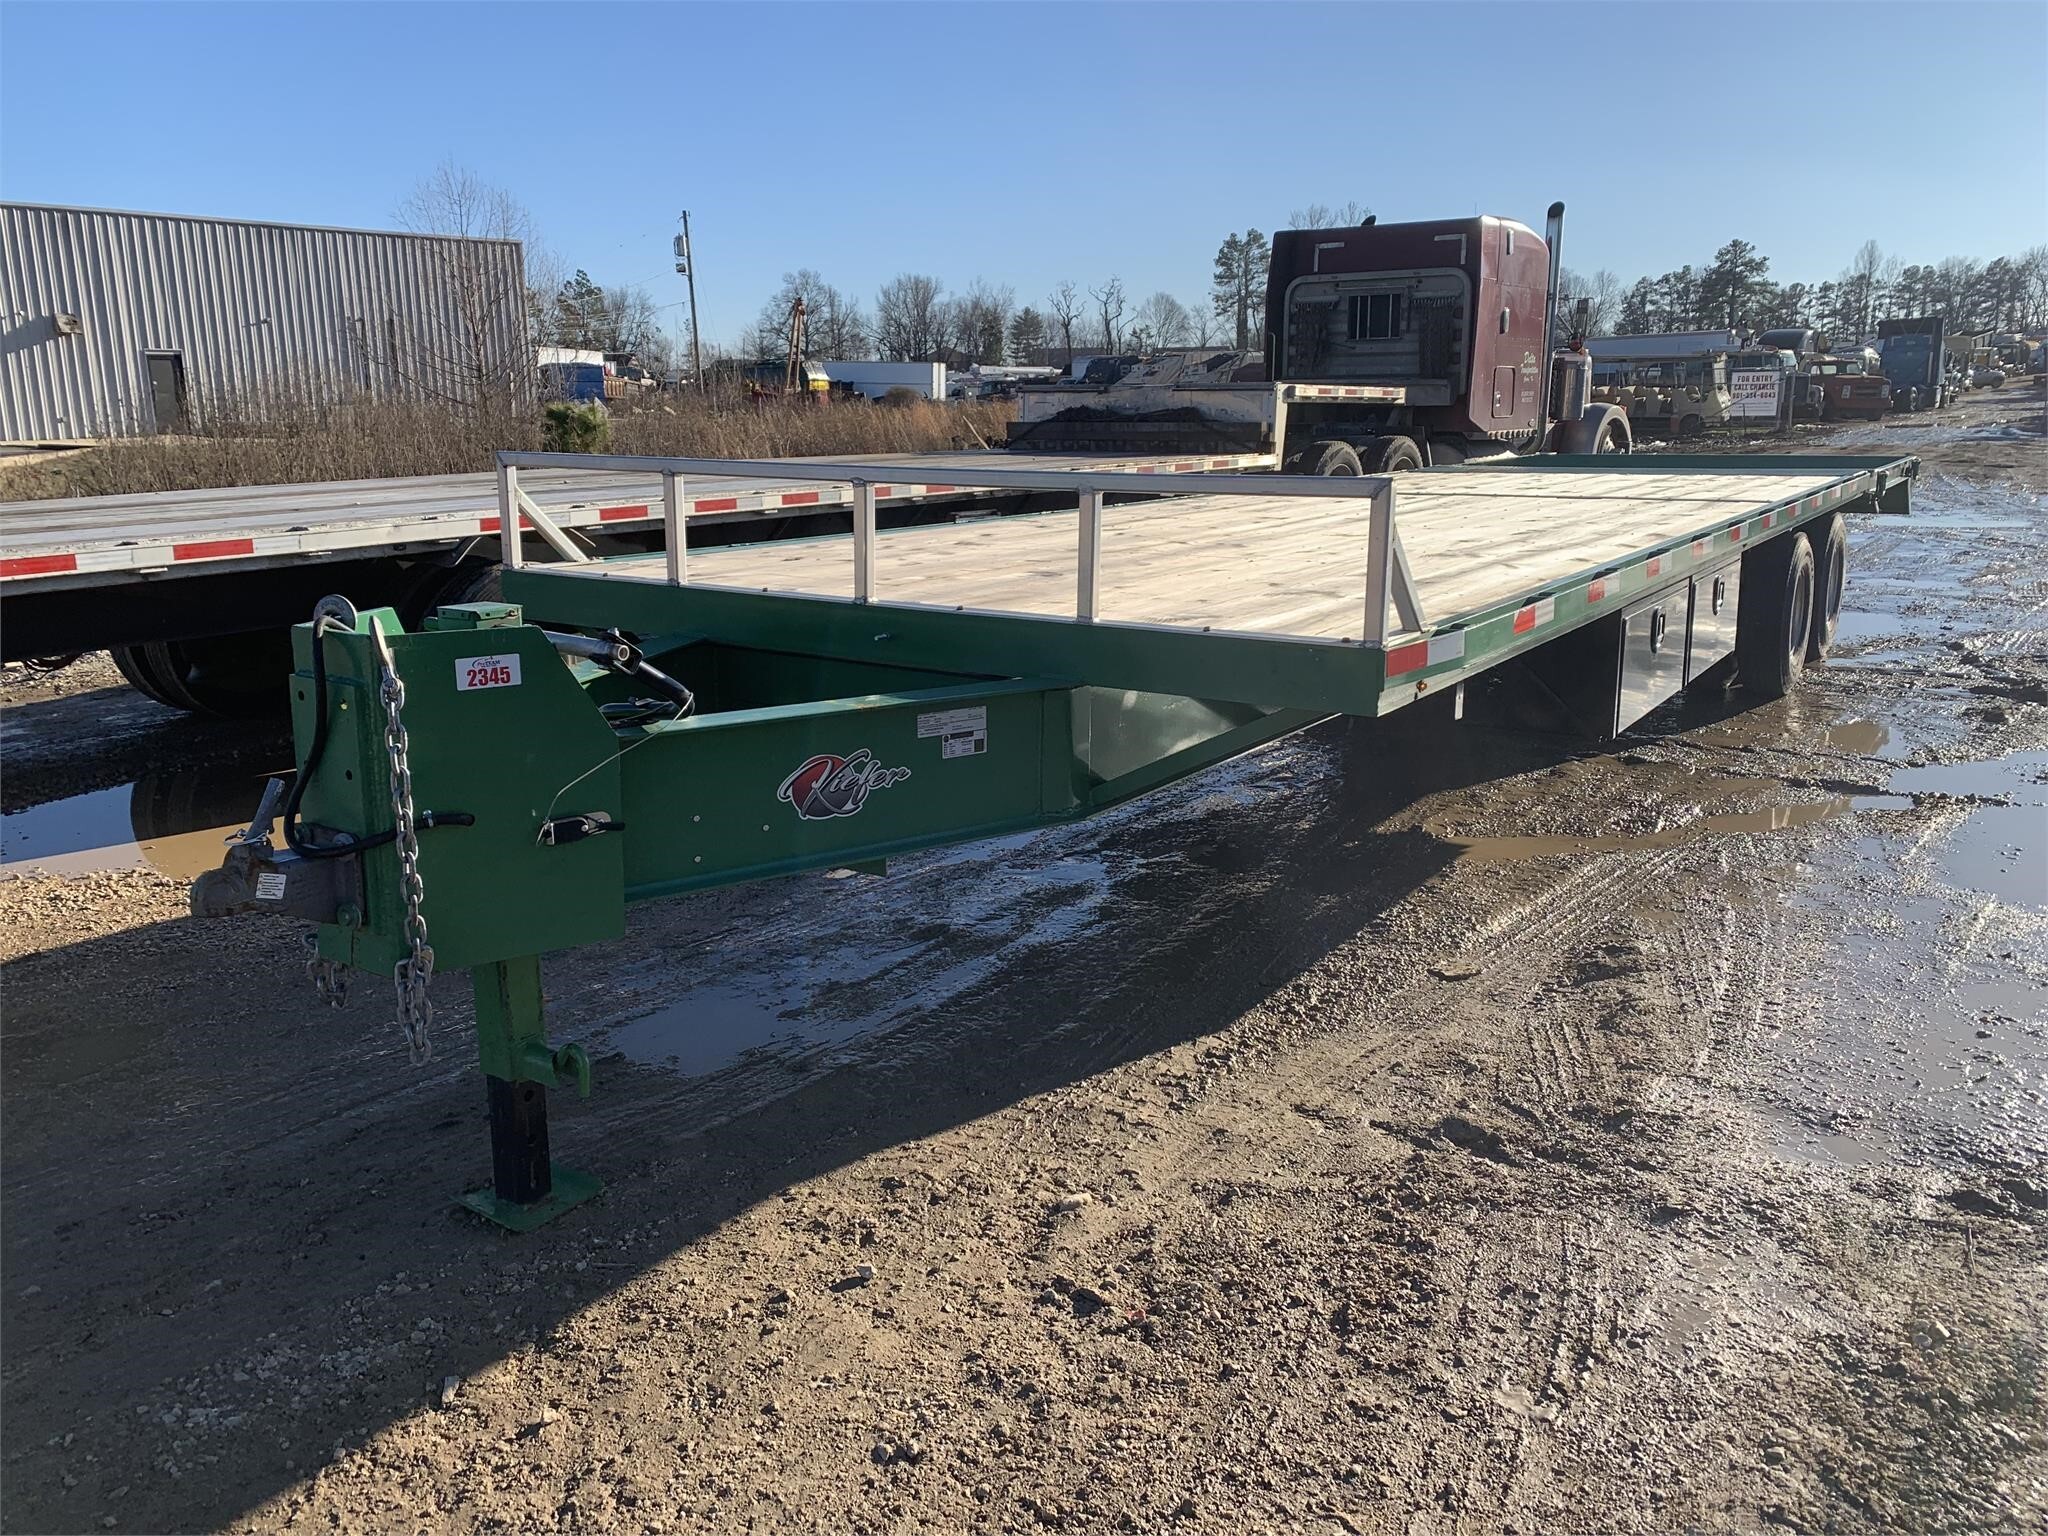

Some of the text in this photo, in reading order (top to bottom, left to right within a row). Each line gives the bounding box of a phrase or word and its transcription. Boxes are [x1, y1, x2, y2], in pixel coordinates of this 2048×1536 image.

[1737, 375, 1774, 383] FOR ENTRY
[1734, 383, 1748, 391] CALL
[466, 666, 511, 688] 2345
[777, 748, 912, 820] Kiefer
